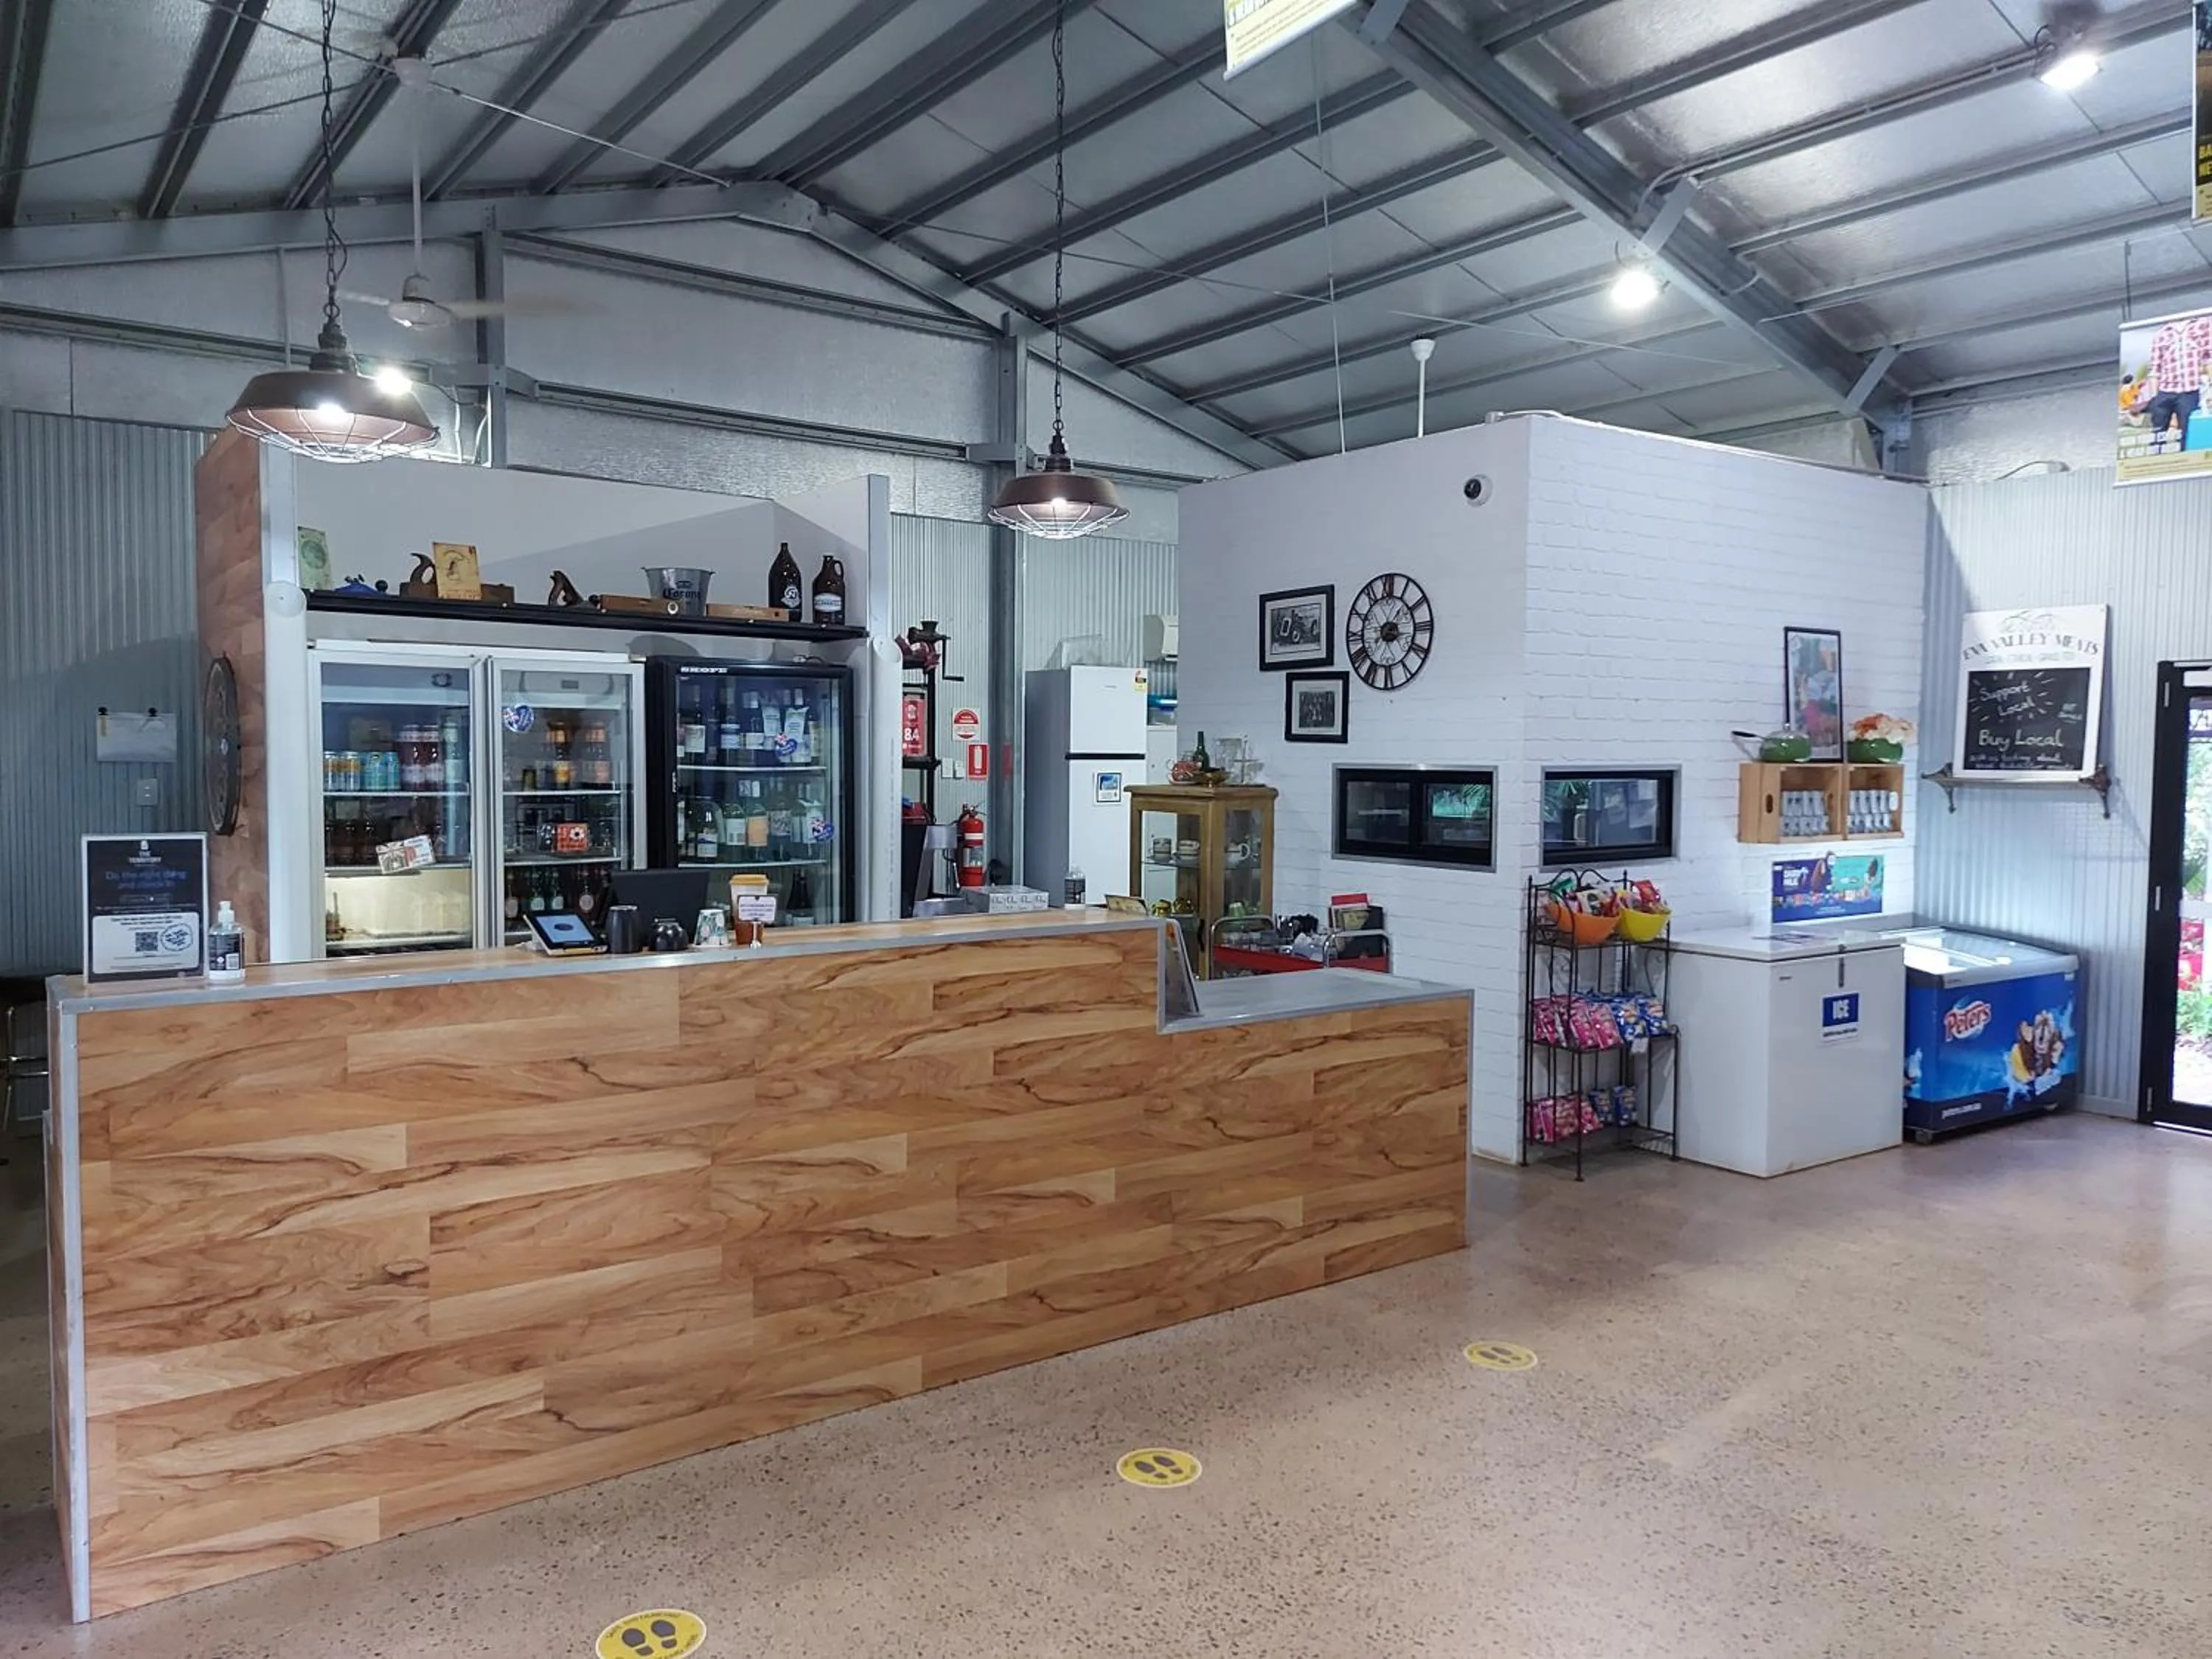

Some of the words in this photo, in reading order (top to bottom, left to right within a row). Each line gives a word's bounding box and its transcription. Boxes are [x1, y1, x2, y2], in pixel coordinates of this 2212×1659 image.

[1980, 681, 2031, 702] Support
[1997, 696, 2035, 716] Local
[1979, 729, 2011, 751] Buy
[2015, 728, 2064, 747] Local
